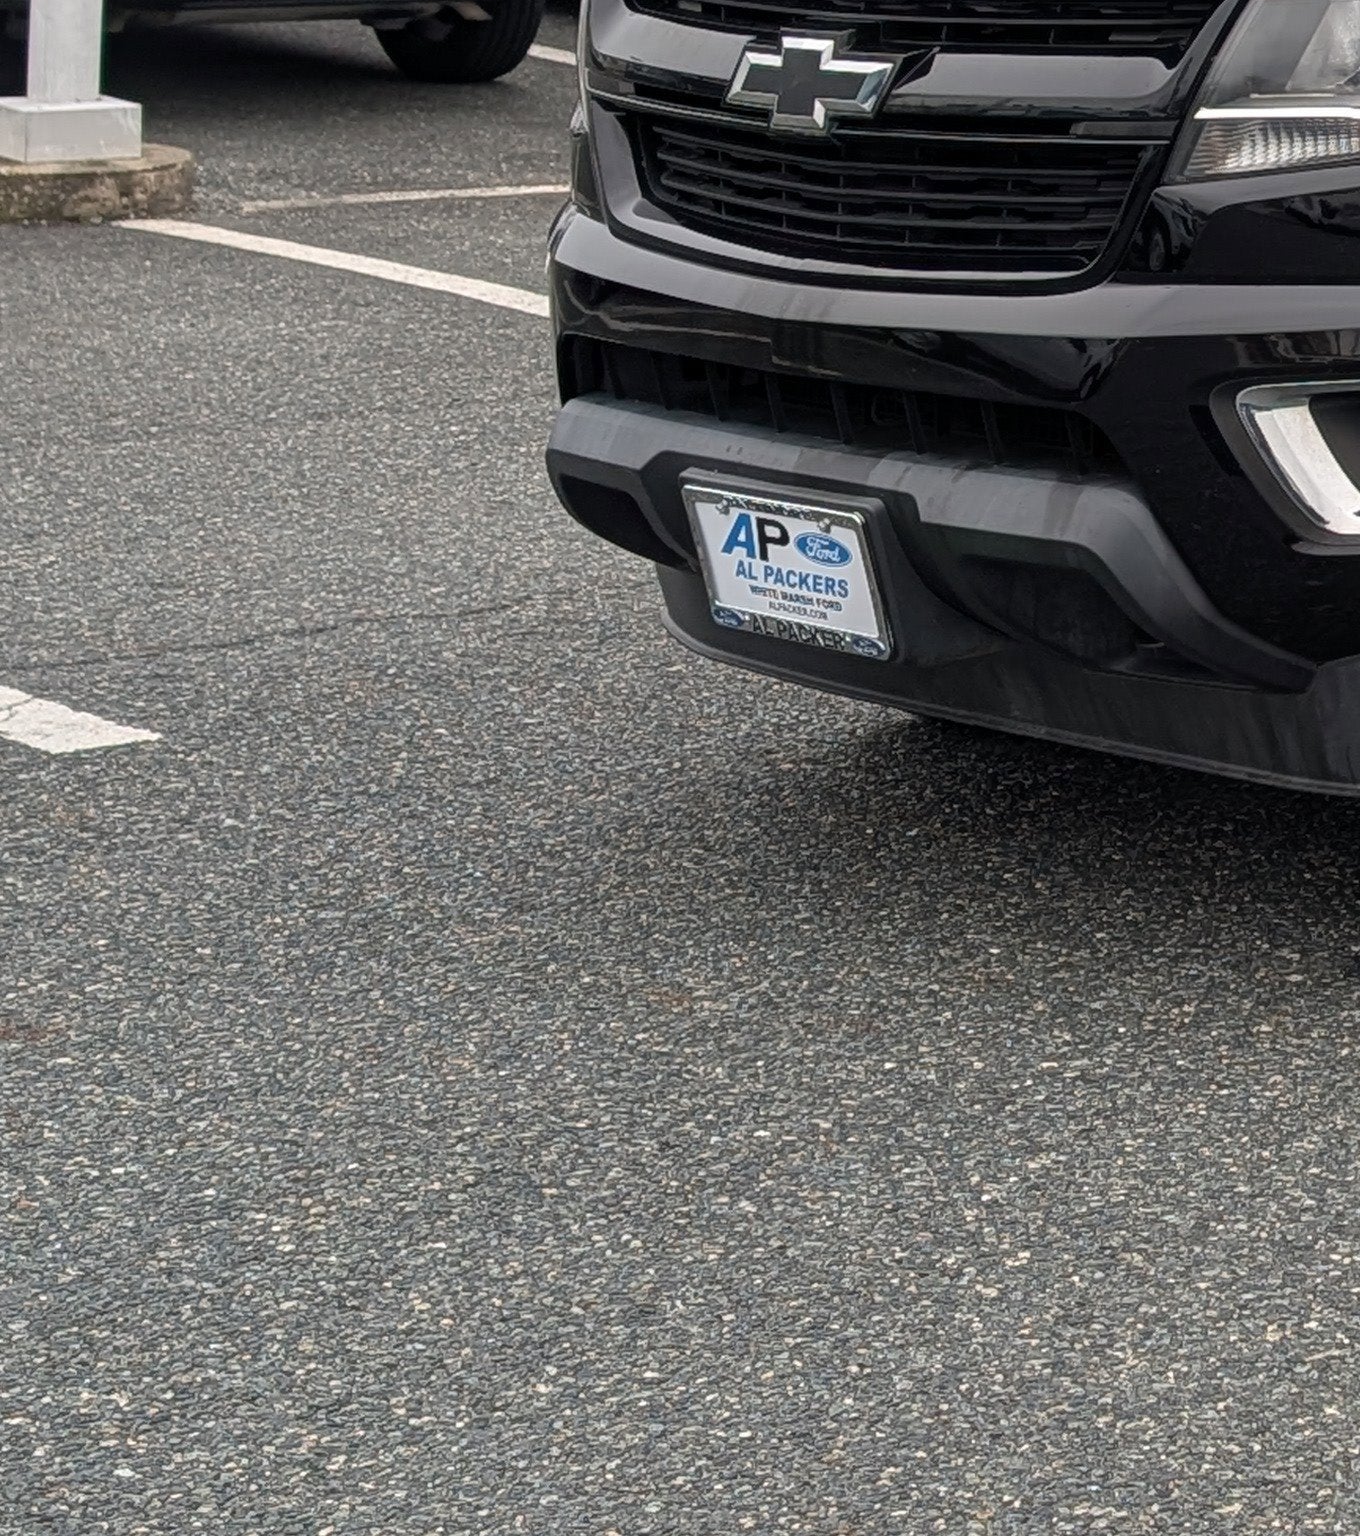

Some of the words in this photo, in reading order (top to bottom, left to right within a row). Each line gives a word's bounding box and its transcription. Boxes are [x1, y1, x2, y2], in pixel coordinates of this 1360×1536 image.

[721, 513, 790, 561] AP
[806, 536, 840, 562] Ford
[735, 560, 758, 581] AL
[763, 565, 849, 598] PACKERS
[753, 614, 774, 634] AL
[777, 621, 846, 651] PACKER
